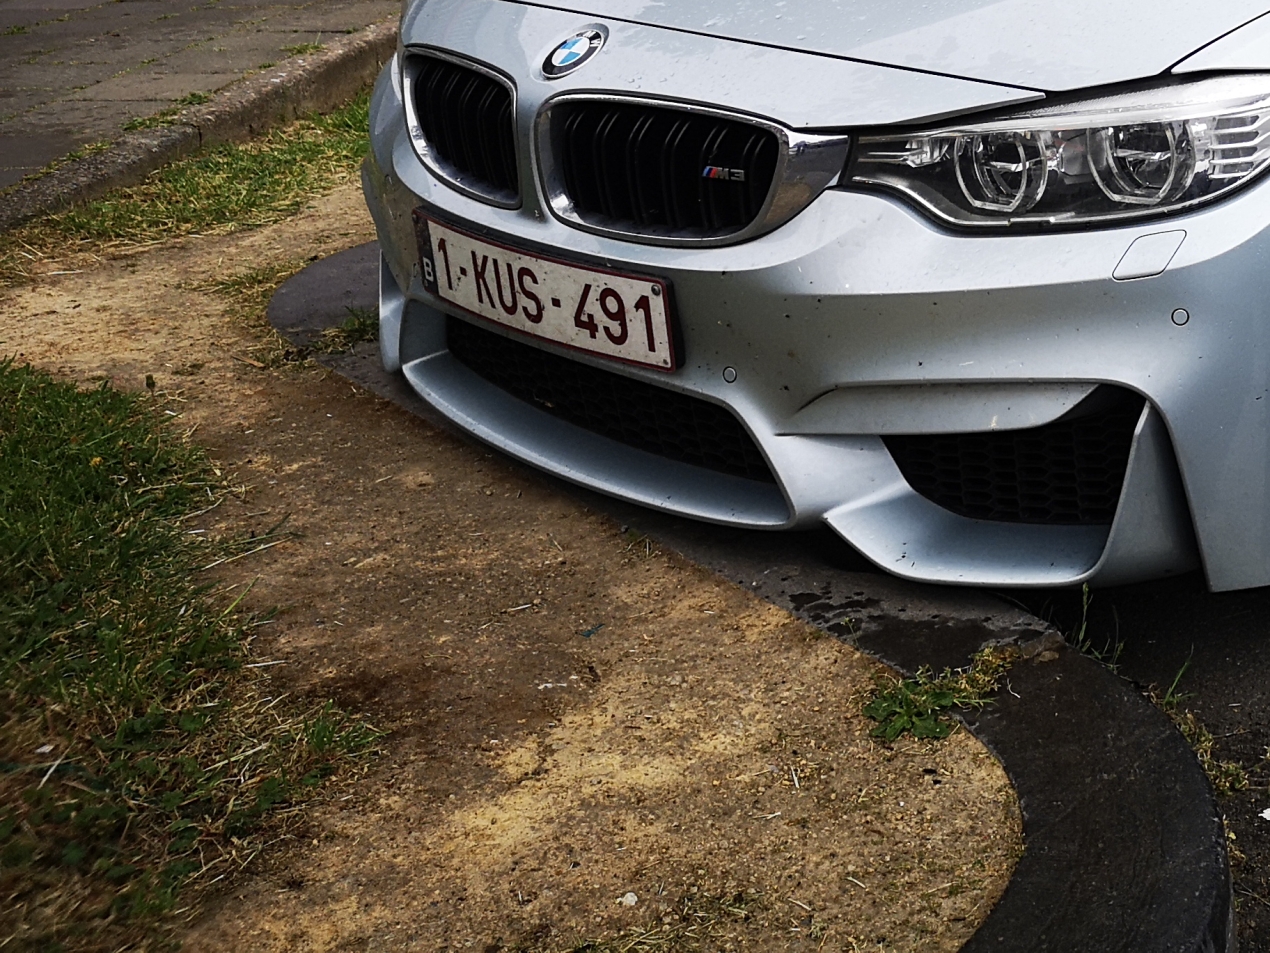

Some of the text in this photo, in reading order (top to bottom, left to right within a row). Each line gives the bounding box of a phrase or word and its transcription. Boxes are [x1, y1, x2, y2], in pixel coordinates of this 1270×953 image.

[706, 165, 746, 182] M3
[422, 256, 435, 282] B
[438, 237, 656, 353] 1-KUS-491
